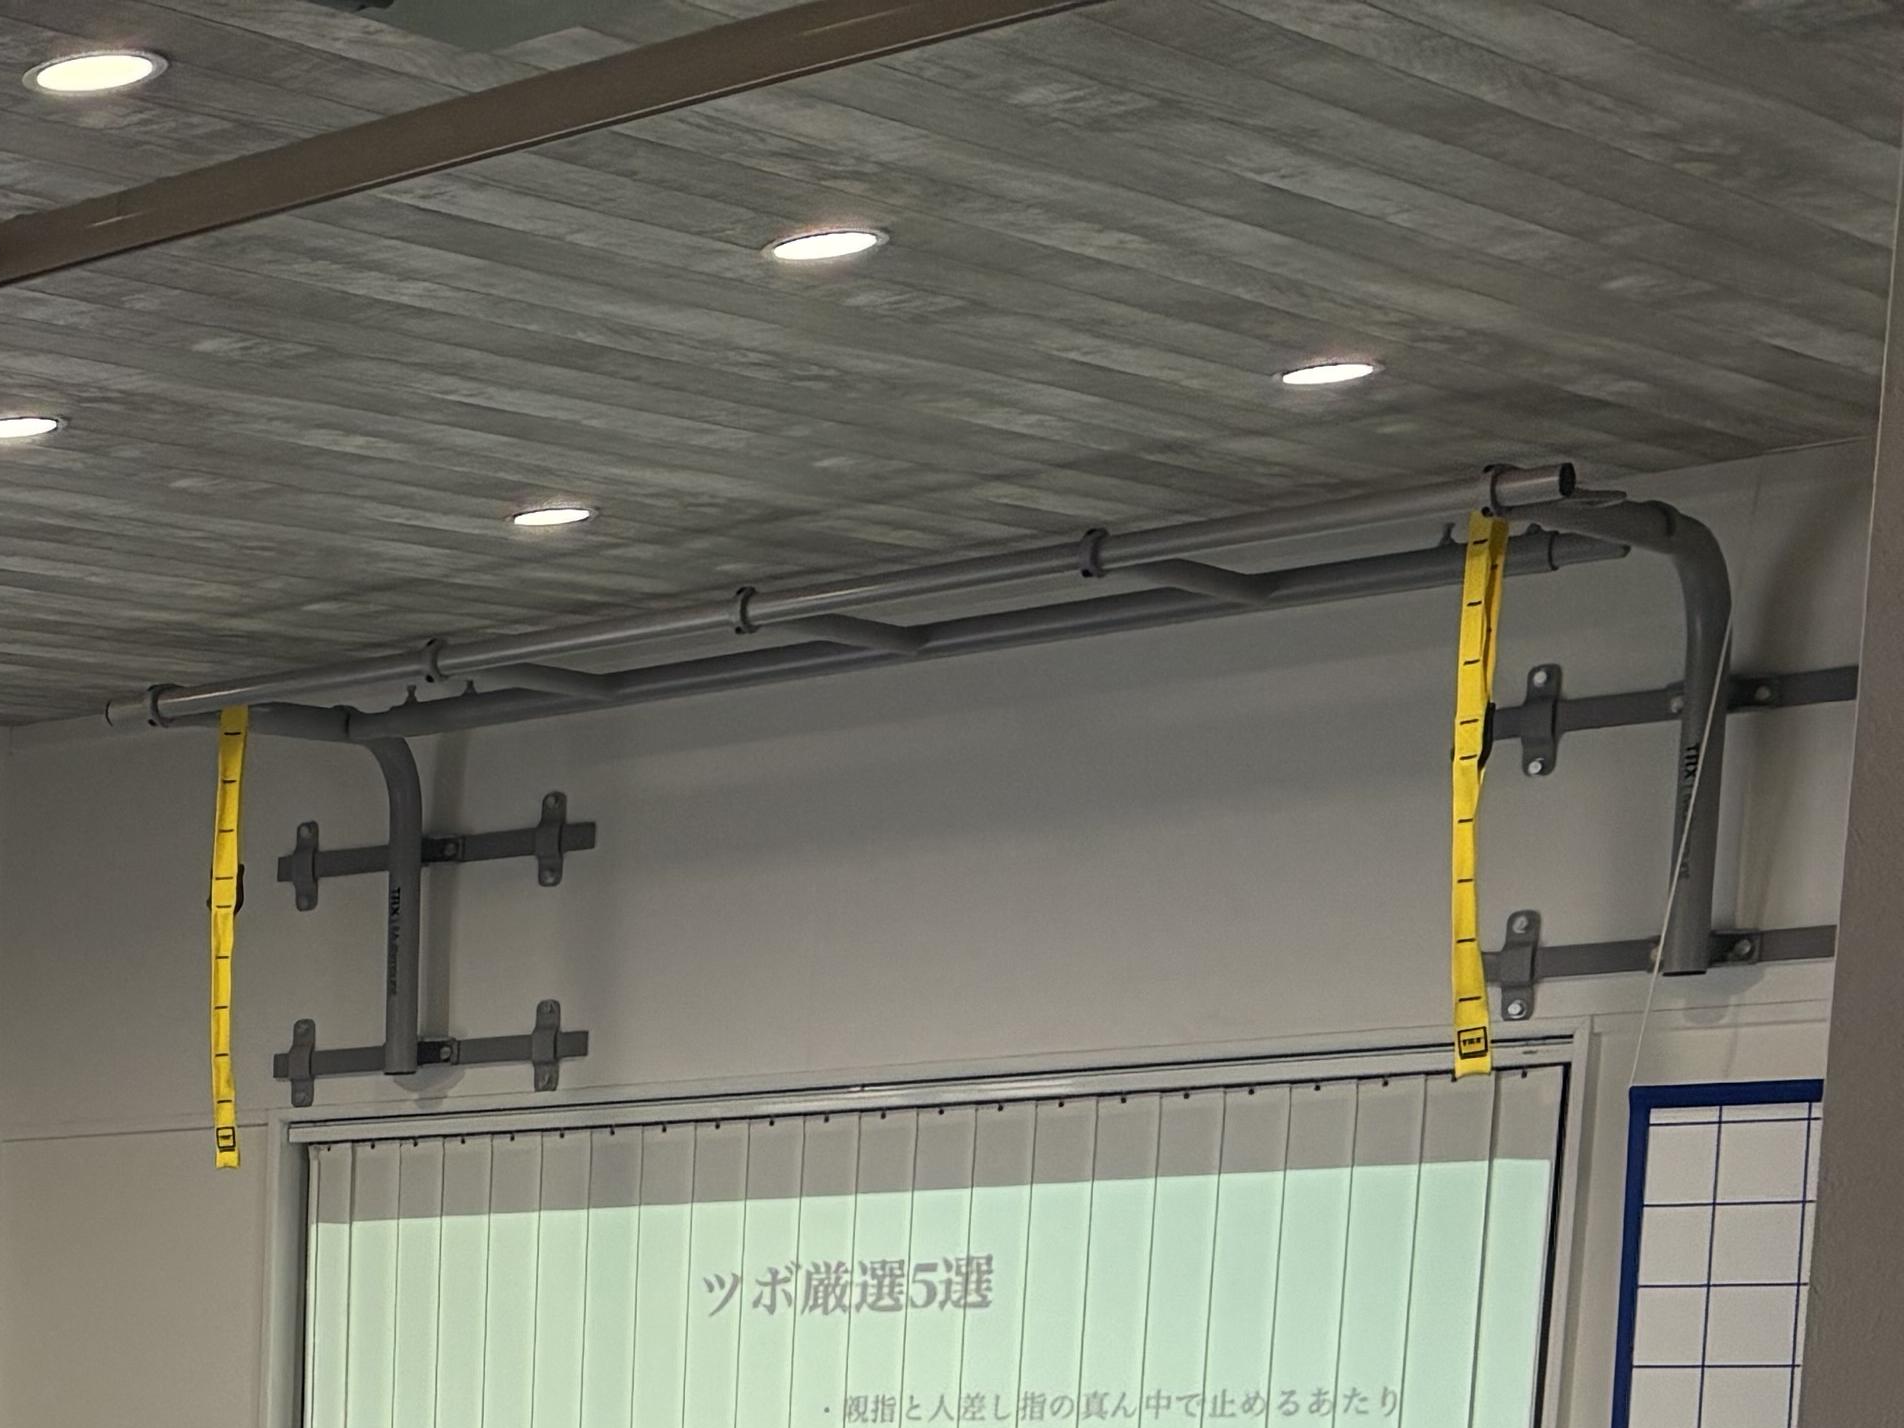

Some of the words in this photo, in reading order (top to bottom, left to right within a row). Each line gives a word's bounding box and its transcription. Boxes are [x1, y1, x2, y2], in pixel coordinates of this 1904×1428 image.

[702, 1253, 994, 1317] ツボ厳選5選
